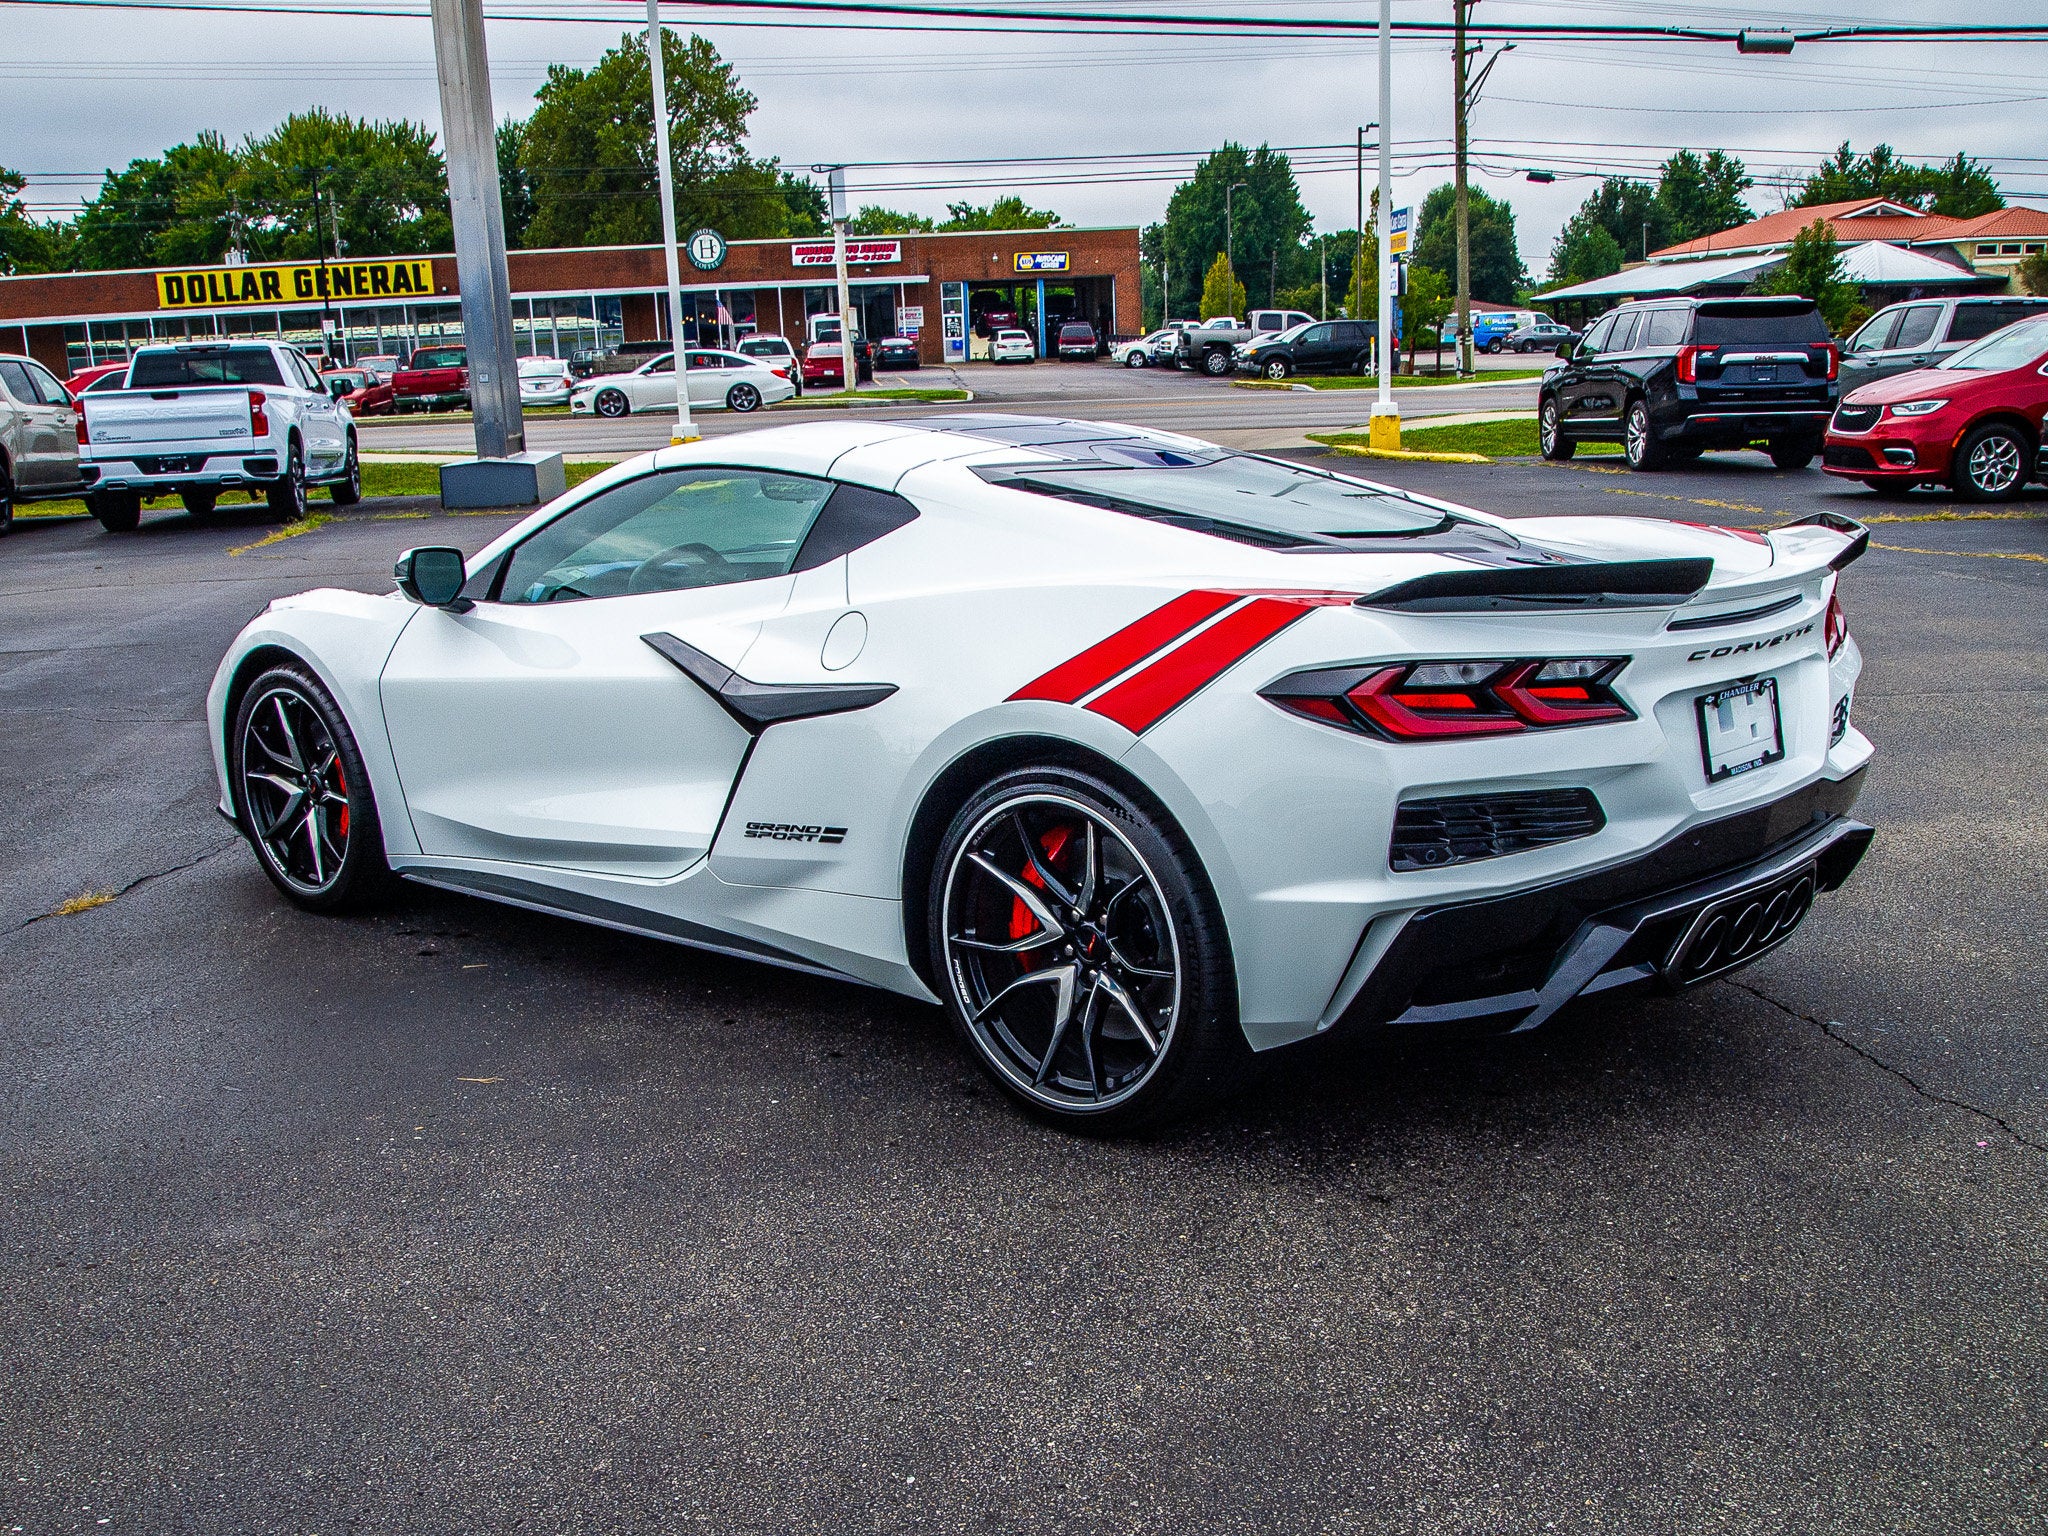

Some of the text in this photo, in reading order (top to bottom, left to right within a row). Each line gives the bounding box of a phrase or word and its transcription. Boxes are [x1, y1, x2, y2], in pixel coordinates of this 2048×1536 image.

[795, 246, 835, 255] MADISON
[860, 243, 897, 253] SERVICE
[694, 260, 721, 270] COFFEE
[164, 263, 429, 304] DOLLAR GENERAL
[1687, 622, 1816, 662] CORVETTE
[1720, 682, 1760, 700] CHANDLER
[746, 821, 822, 834] GRAND
[744, 830, 820, 842] SPORT
[953, 959, 970, 1004] FORGED
